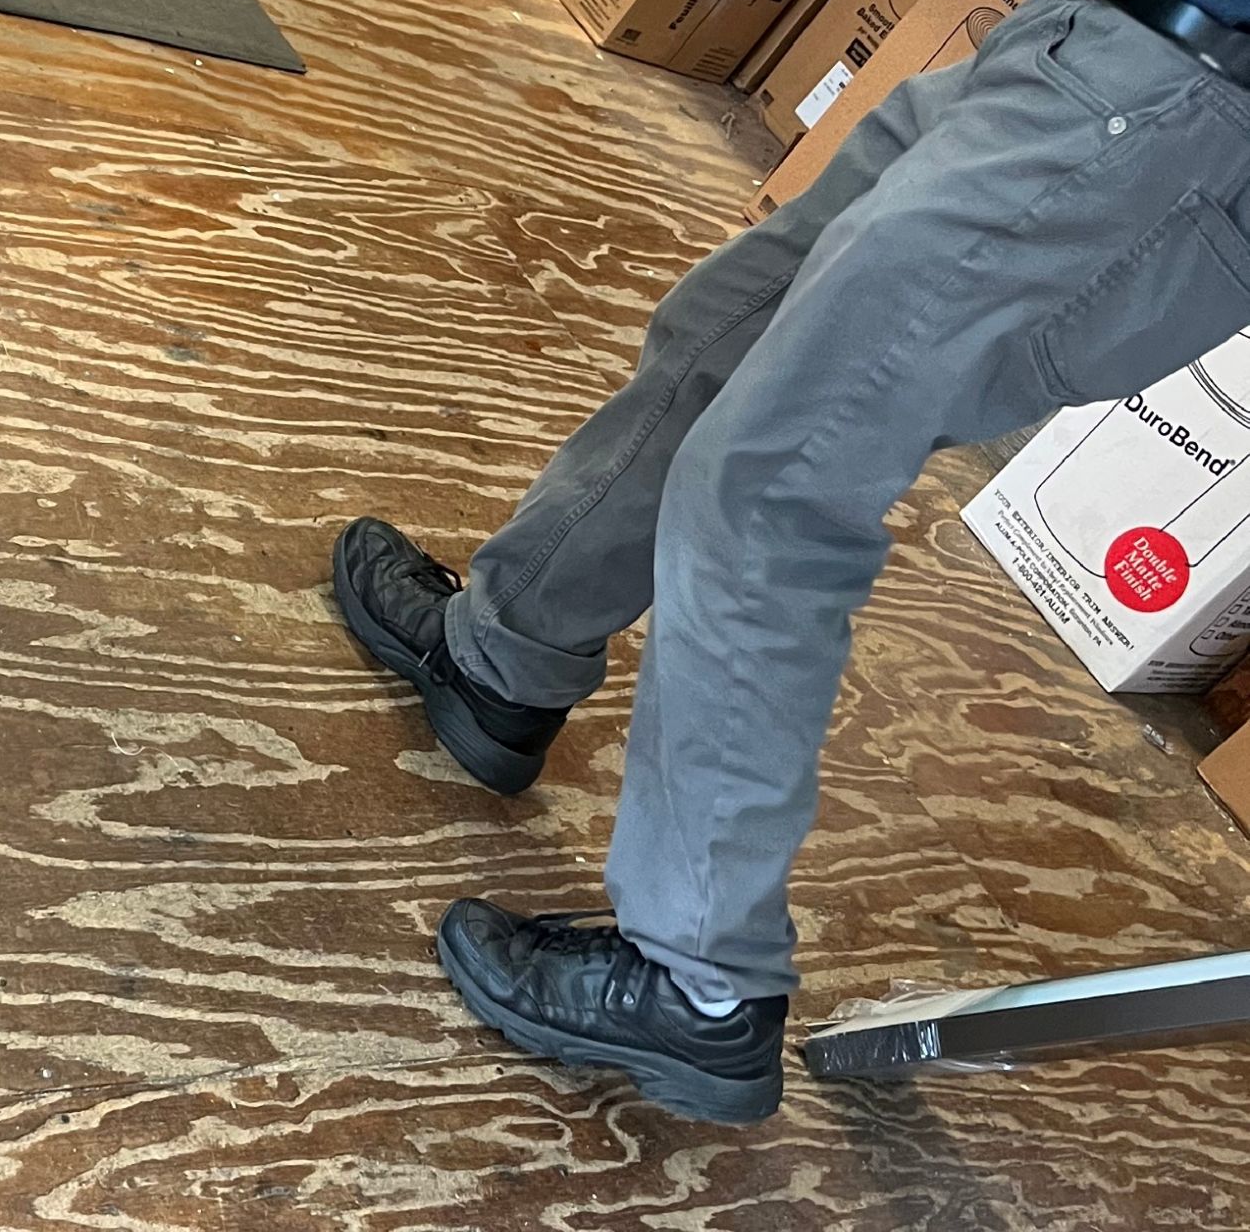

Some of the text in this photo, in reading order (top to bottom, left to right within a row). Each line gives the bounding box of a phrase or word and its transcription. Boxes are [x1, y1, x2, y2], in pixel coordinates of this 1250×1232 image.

[1006, 511, 1080, 591] EXTERIOR/INTERIOR
[1082, 593, 1101, 614] TRIM
[1114, 560, 1152, 602] Finish
[1125, 550, 1163, 591] Matte
[1133, 537, 1178, 584] Double
[1011, 557, 1072, 625] 1-800-421-ALUM
[1093, 636, 1101, 646] PA
